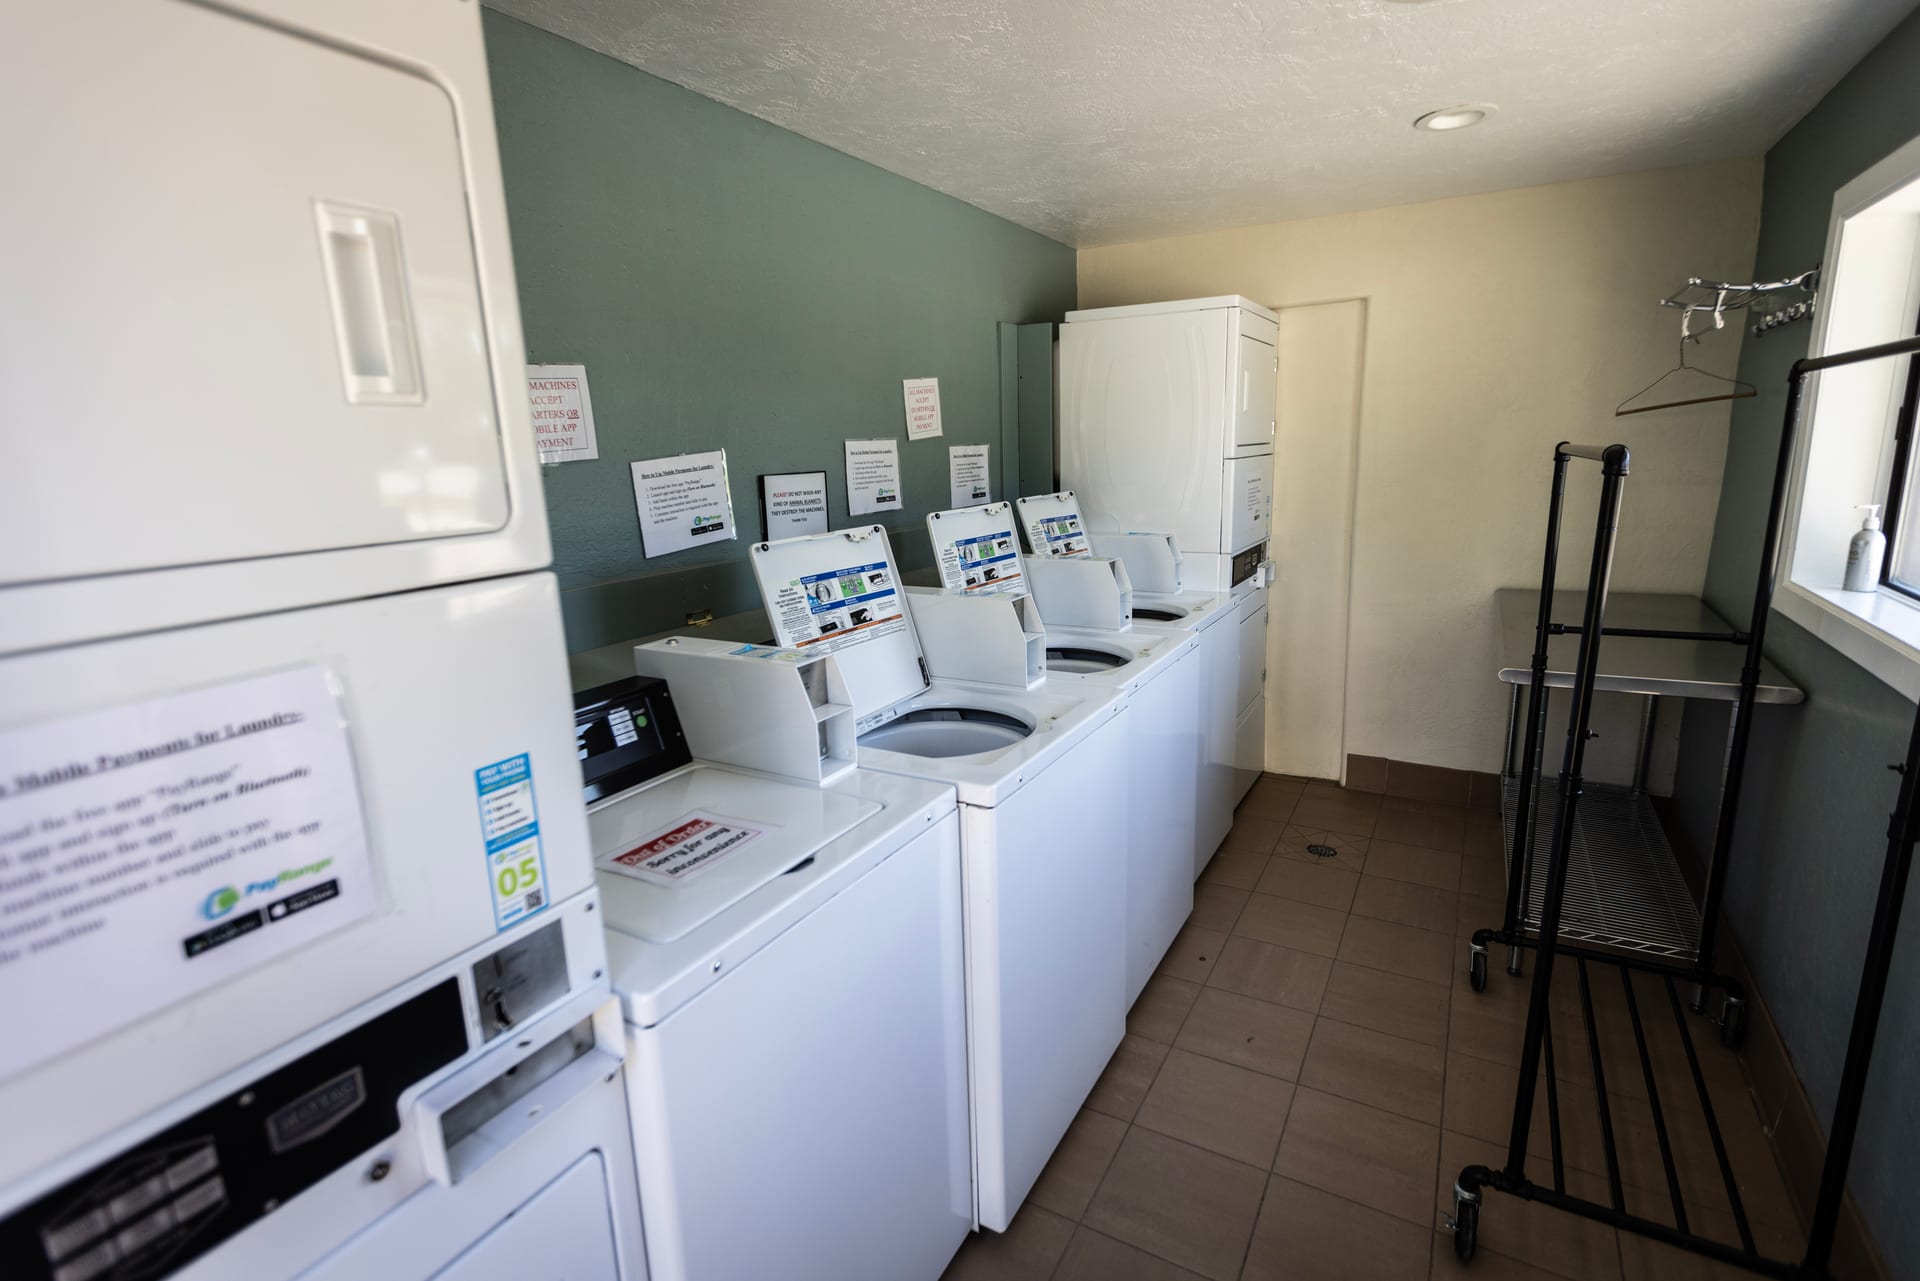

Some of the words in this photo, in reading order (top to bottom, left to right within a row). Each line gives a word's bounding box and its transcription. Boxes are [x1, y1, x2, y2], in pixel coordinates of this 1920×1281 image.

[529, 381, 577, 390] MACHINES
[567, 409, 579, 419] OR
[561, 424, 577, 433] APP
[704, 827, 730, 841] any
[497, 856, 538, 897] 05
